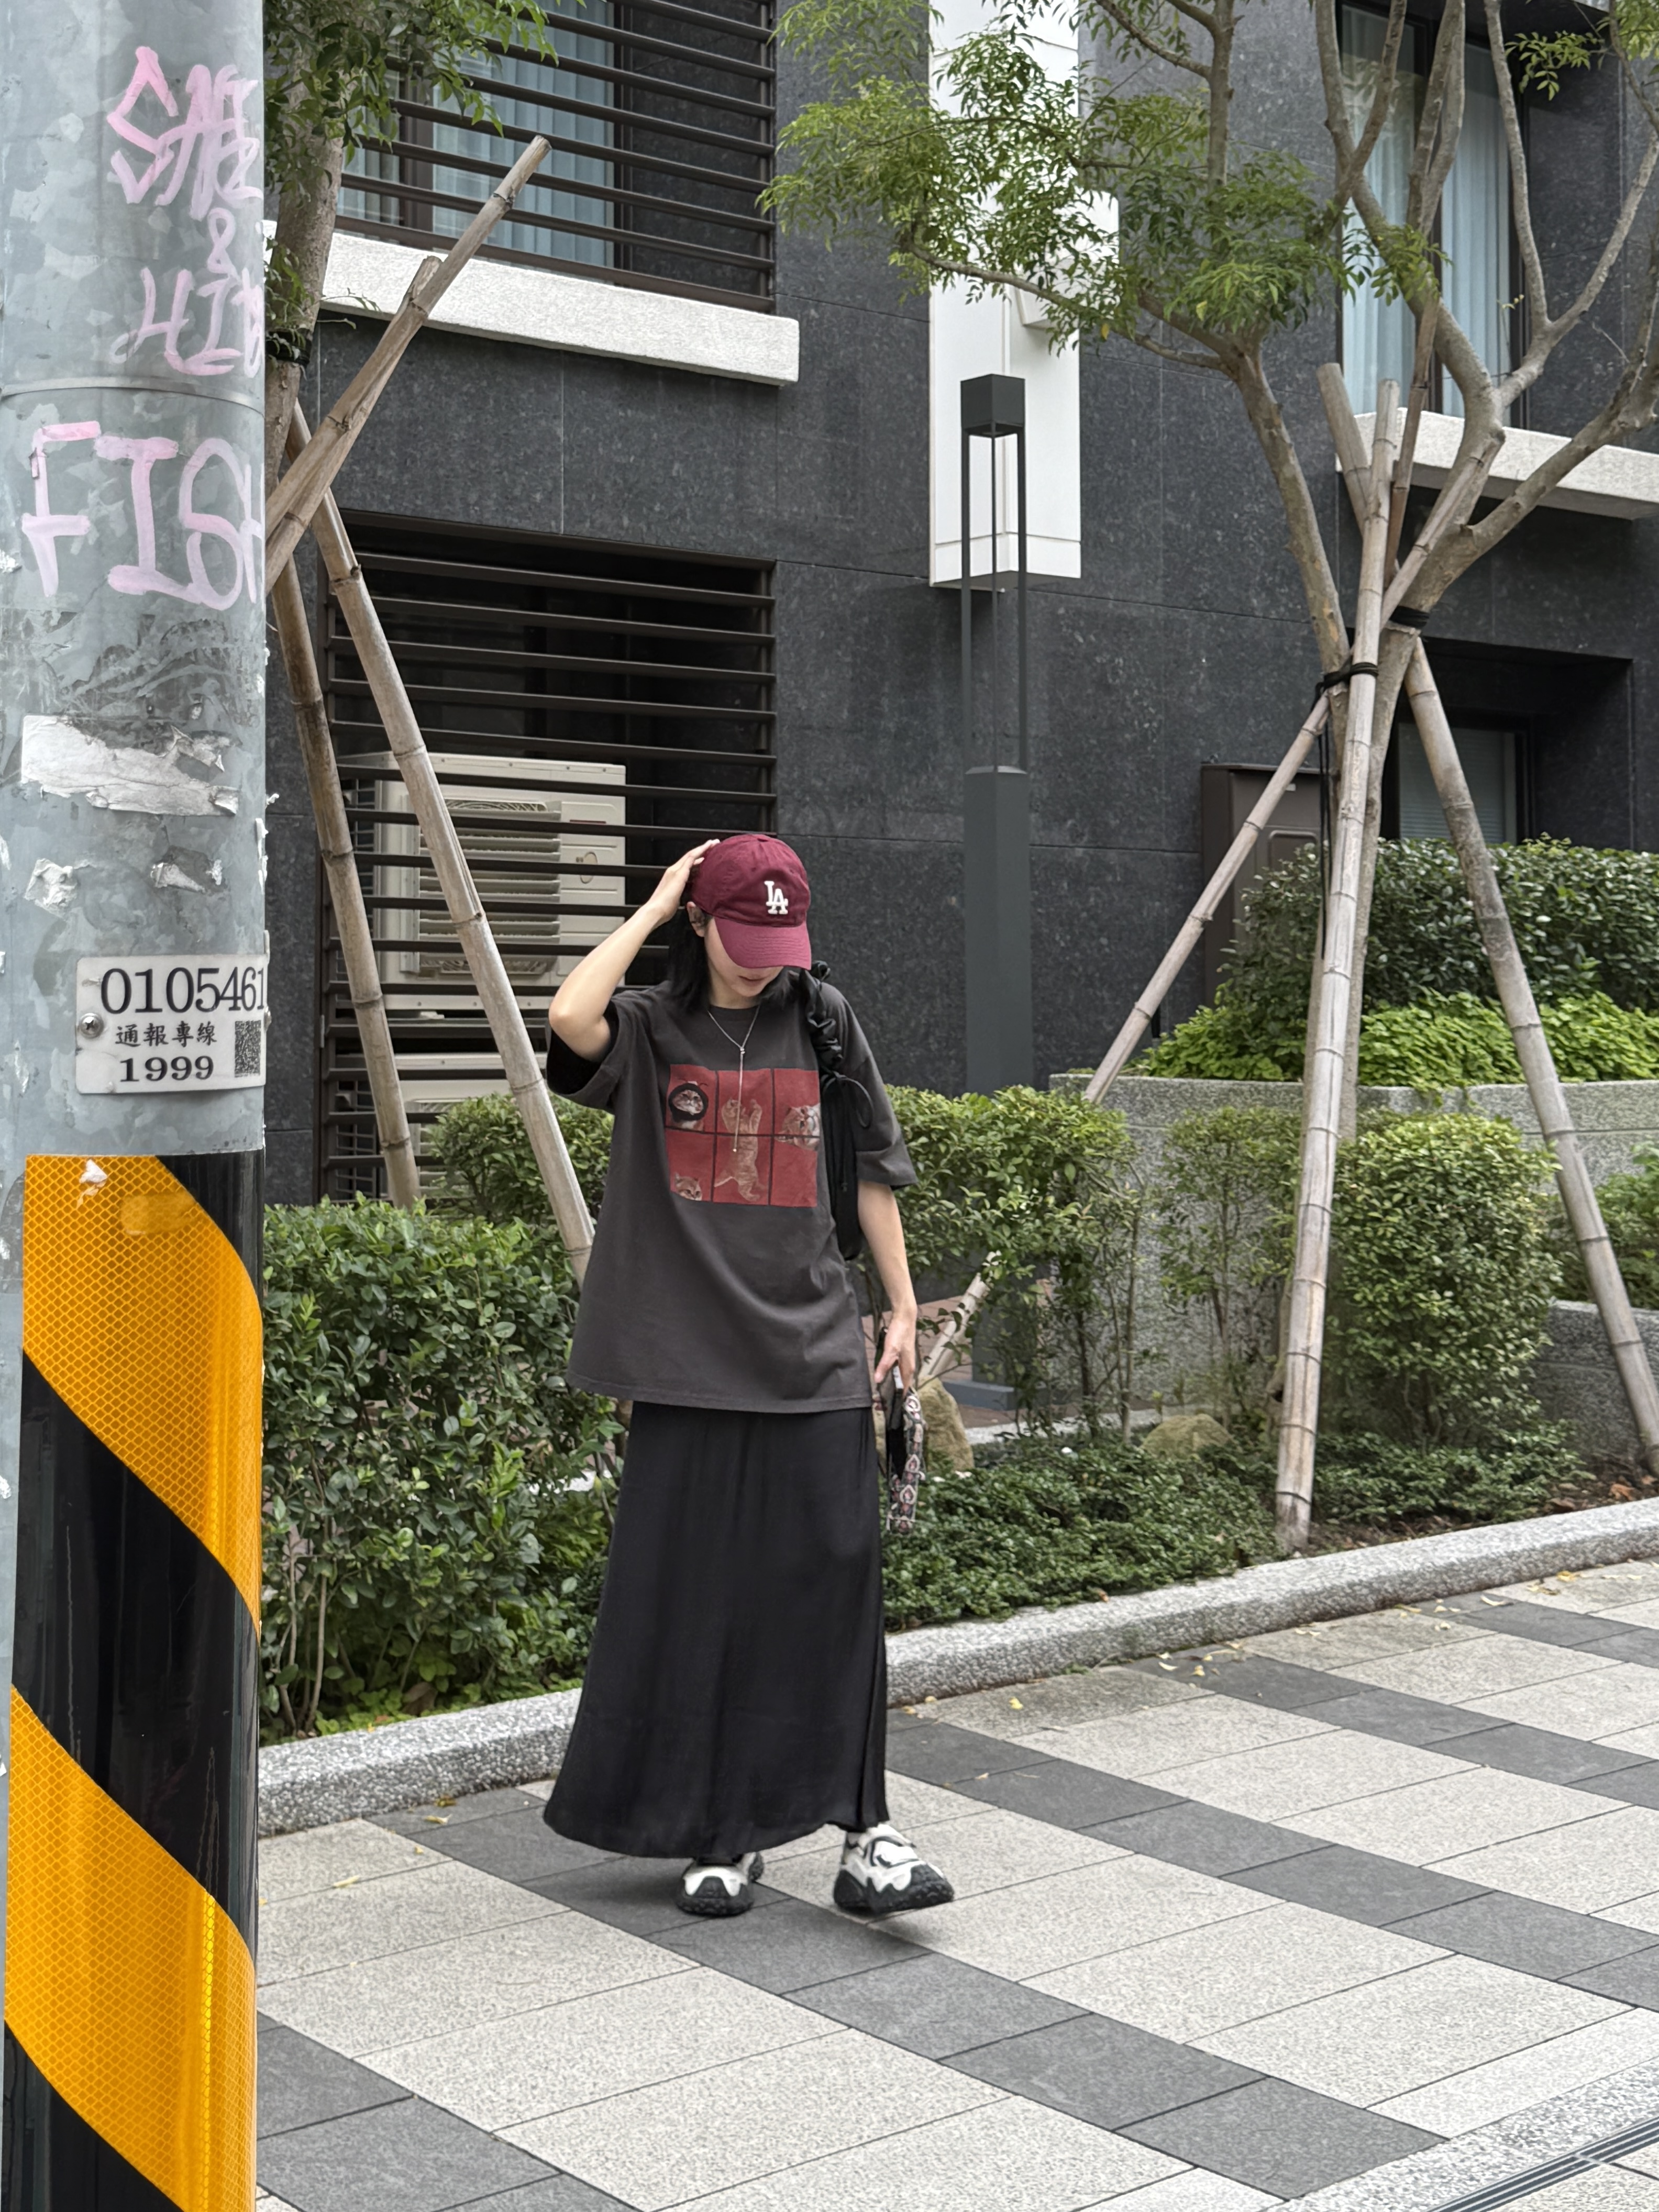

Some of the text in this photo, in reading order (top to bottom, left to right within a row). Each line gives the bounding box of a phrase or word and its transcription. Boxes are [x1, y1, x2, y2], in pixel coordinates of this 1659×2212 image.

[764, 880, 789, 915] LA
[101, 966, 264, 1014] 0105461
[115, 1020, 217, 1048] 通報專線
[119, 1055, 214, 1082] 1999
